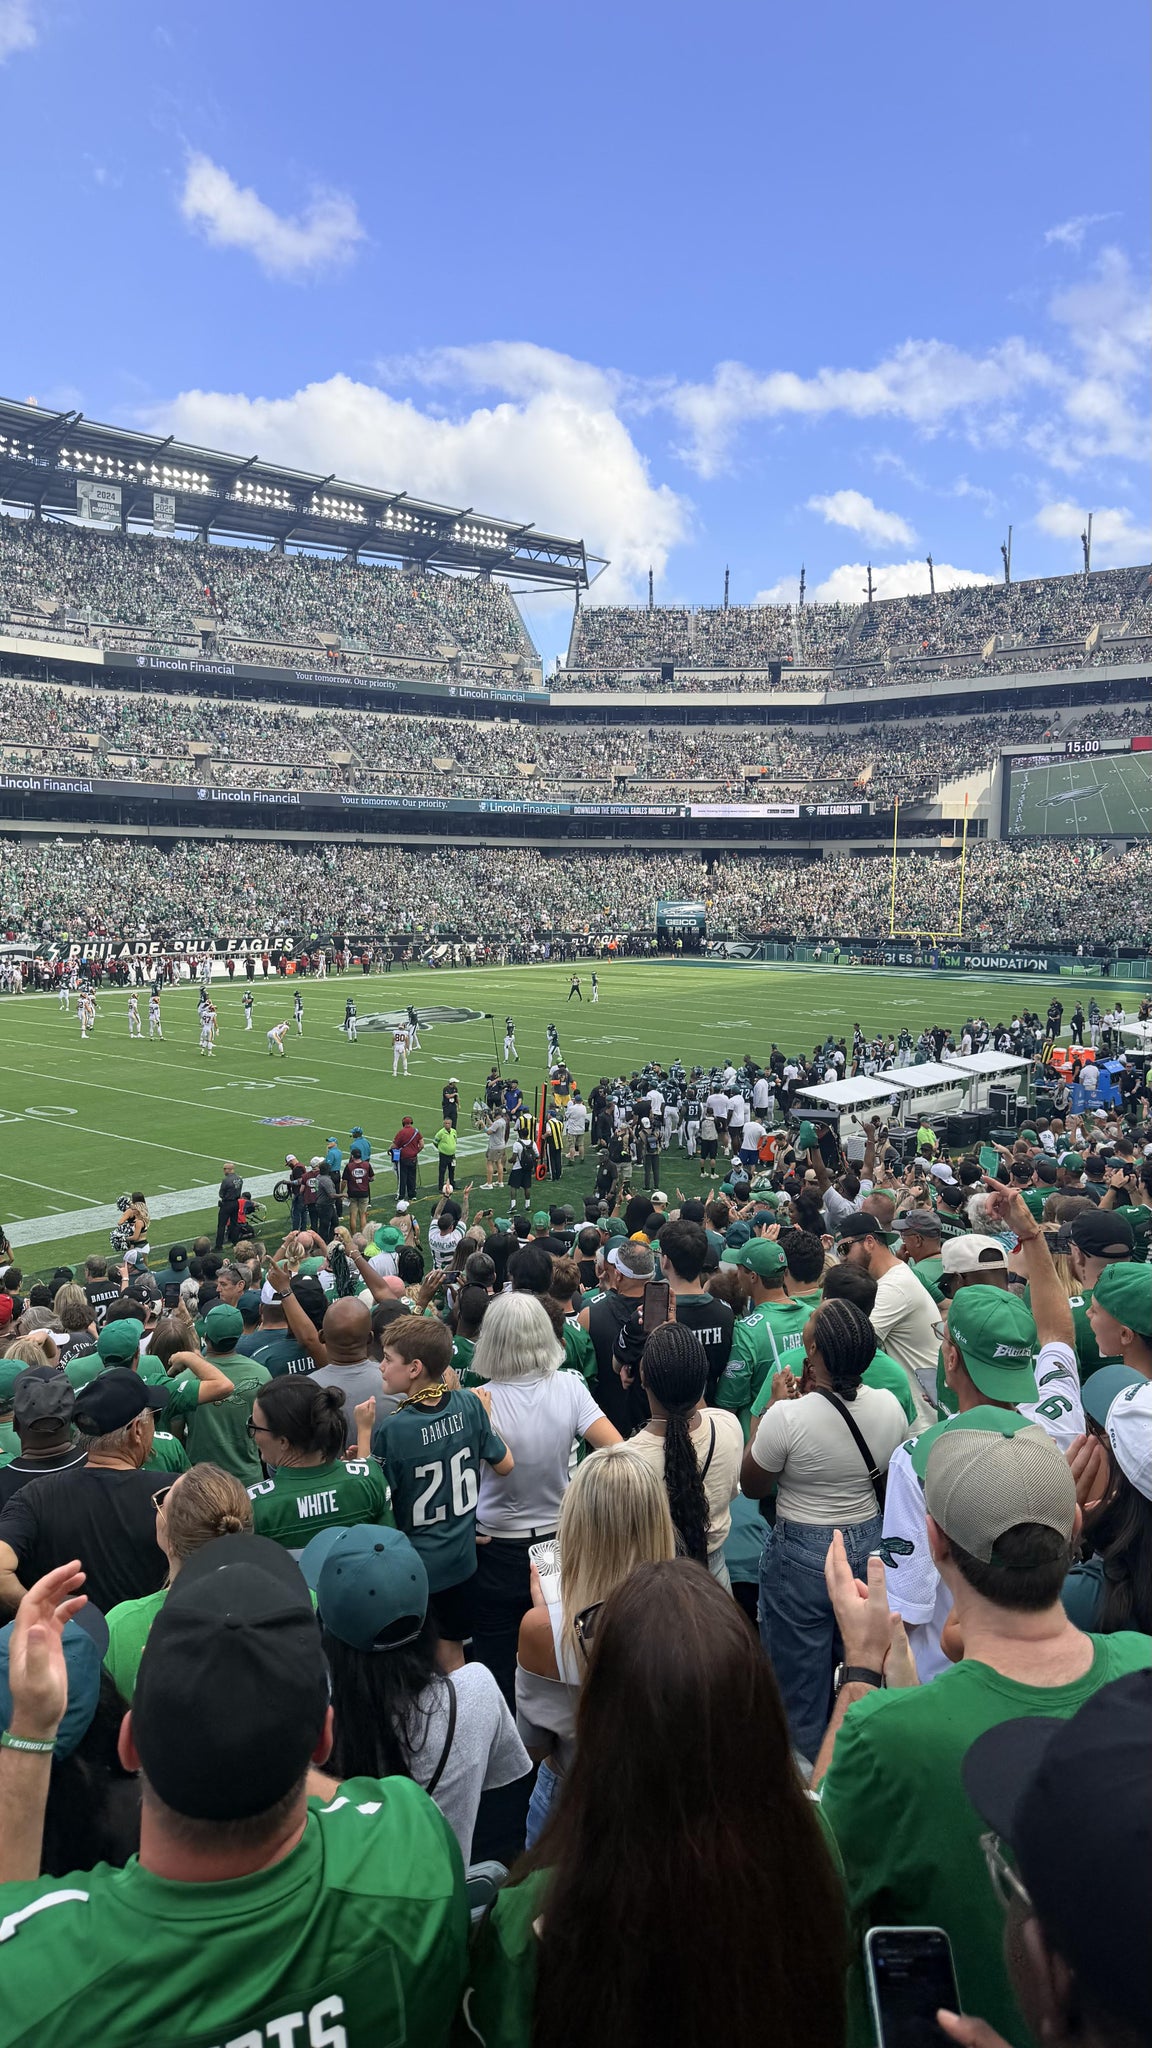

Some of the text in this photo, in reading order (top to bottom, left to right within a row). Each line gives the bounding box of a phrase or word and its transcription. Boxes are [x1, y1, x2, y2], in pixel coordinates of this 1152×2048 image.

[96, 490, 115, 501] 2024
[150, 657, 235, 675] Lincoln Financial
[295, 671, 398, 690] Your tomorrow. Our priority.
[459, 687, 526, 702] Lincoln Financial
[1067, 741, 1099, 752] 15:00
[0, 776, 94, 792] Lincoln Financial
[212, 789, 300, 804] Lincoln Financial
[341, 795, 449, 809] Your tomorrow. Our priority.
[490, 802, 560, 815] Lincoln Financial
[574, 806, 677, 815] DOWNLOAD THE OFFICIAL EAGLES MOBILE APP
[817, 806, 830, 815] FREE
[830, 805, 850, 815] EAGLES
[227, 938, 294, 952] EAGLES
[395, 1034, 406, 1042] 80
[227, 1075, 318, 1091] 30
[91, 1290, 120, 1304] BARKLEY
[421, 1412, 464, 1446] BARKLEY
[413, 1446, 479, 1527] 26
[296, 1490, 340, 1519] WHITE
